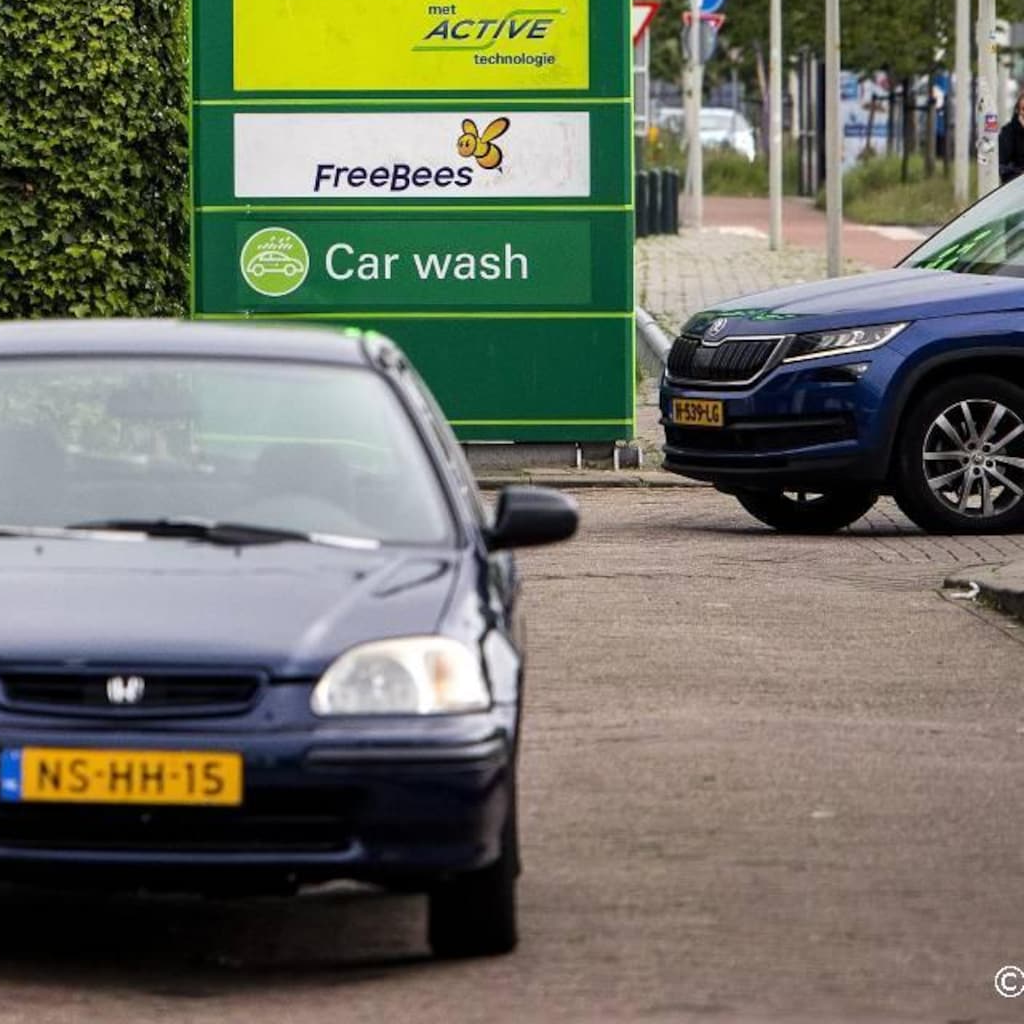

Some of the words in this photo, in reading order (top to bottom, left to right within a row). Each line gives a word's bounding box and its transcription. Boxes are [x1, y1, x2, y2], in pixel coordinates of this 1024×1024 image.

[428, 4, 456, 15] met
[423, 19, 553, 40] ACTIVE
[474, 53, 555, 67] technologie
[313, 164, 473, 192] FreeBees
[325, 243, 399, 280] Car
[414, 243, 529, 280] wash
[37, 759, 225, 795] NS-HH-15
